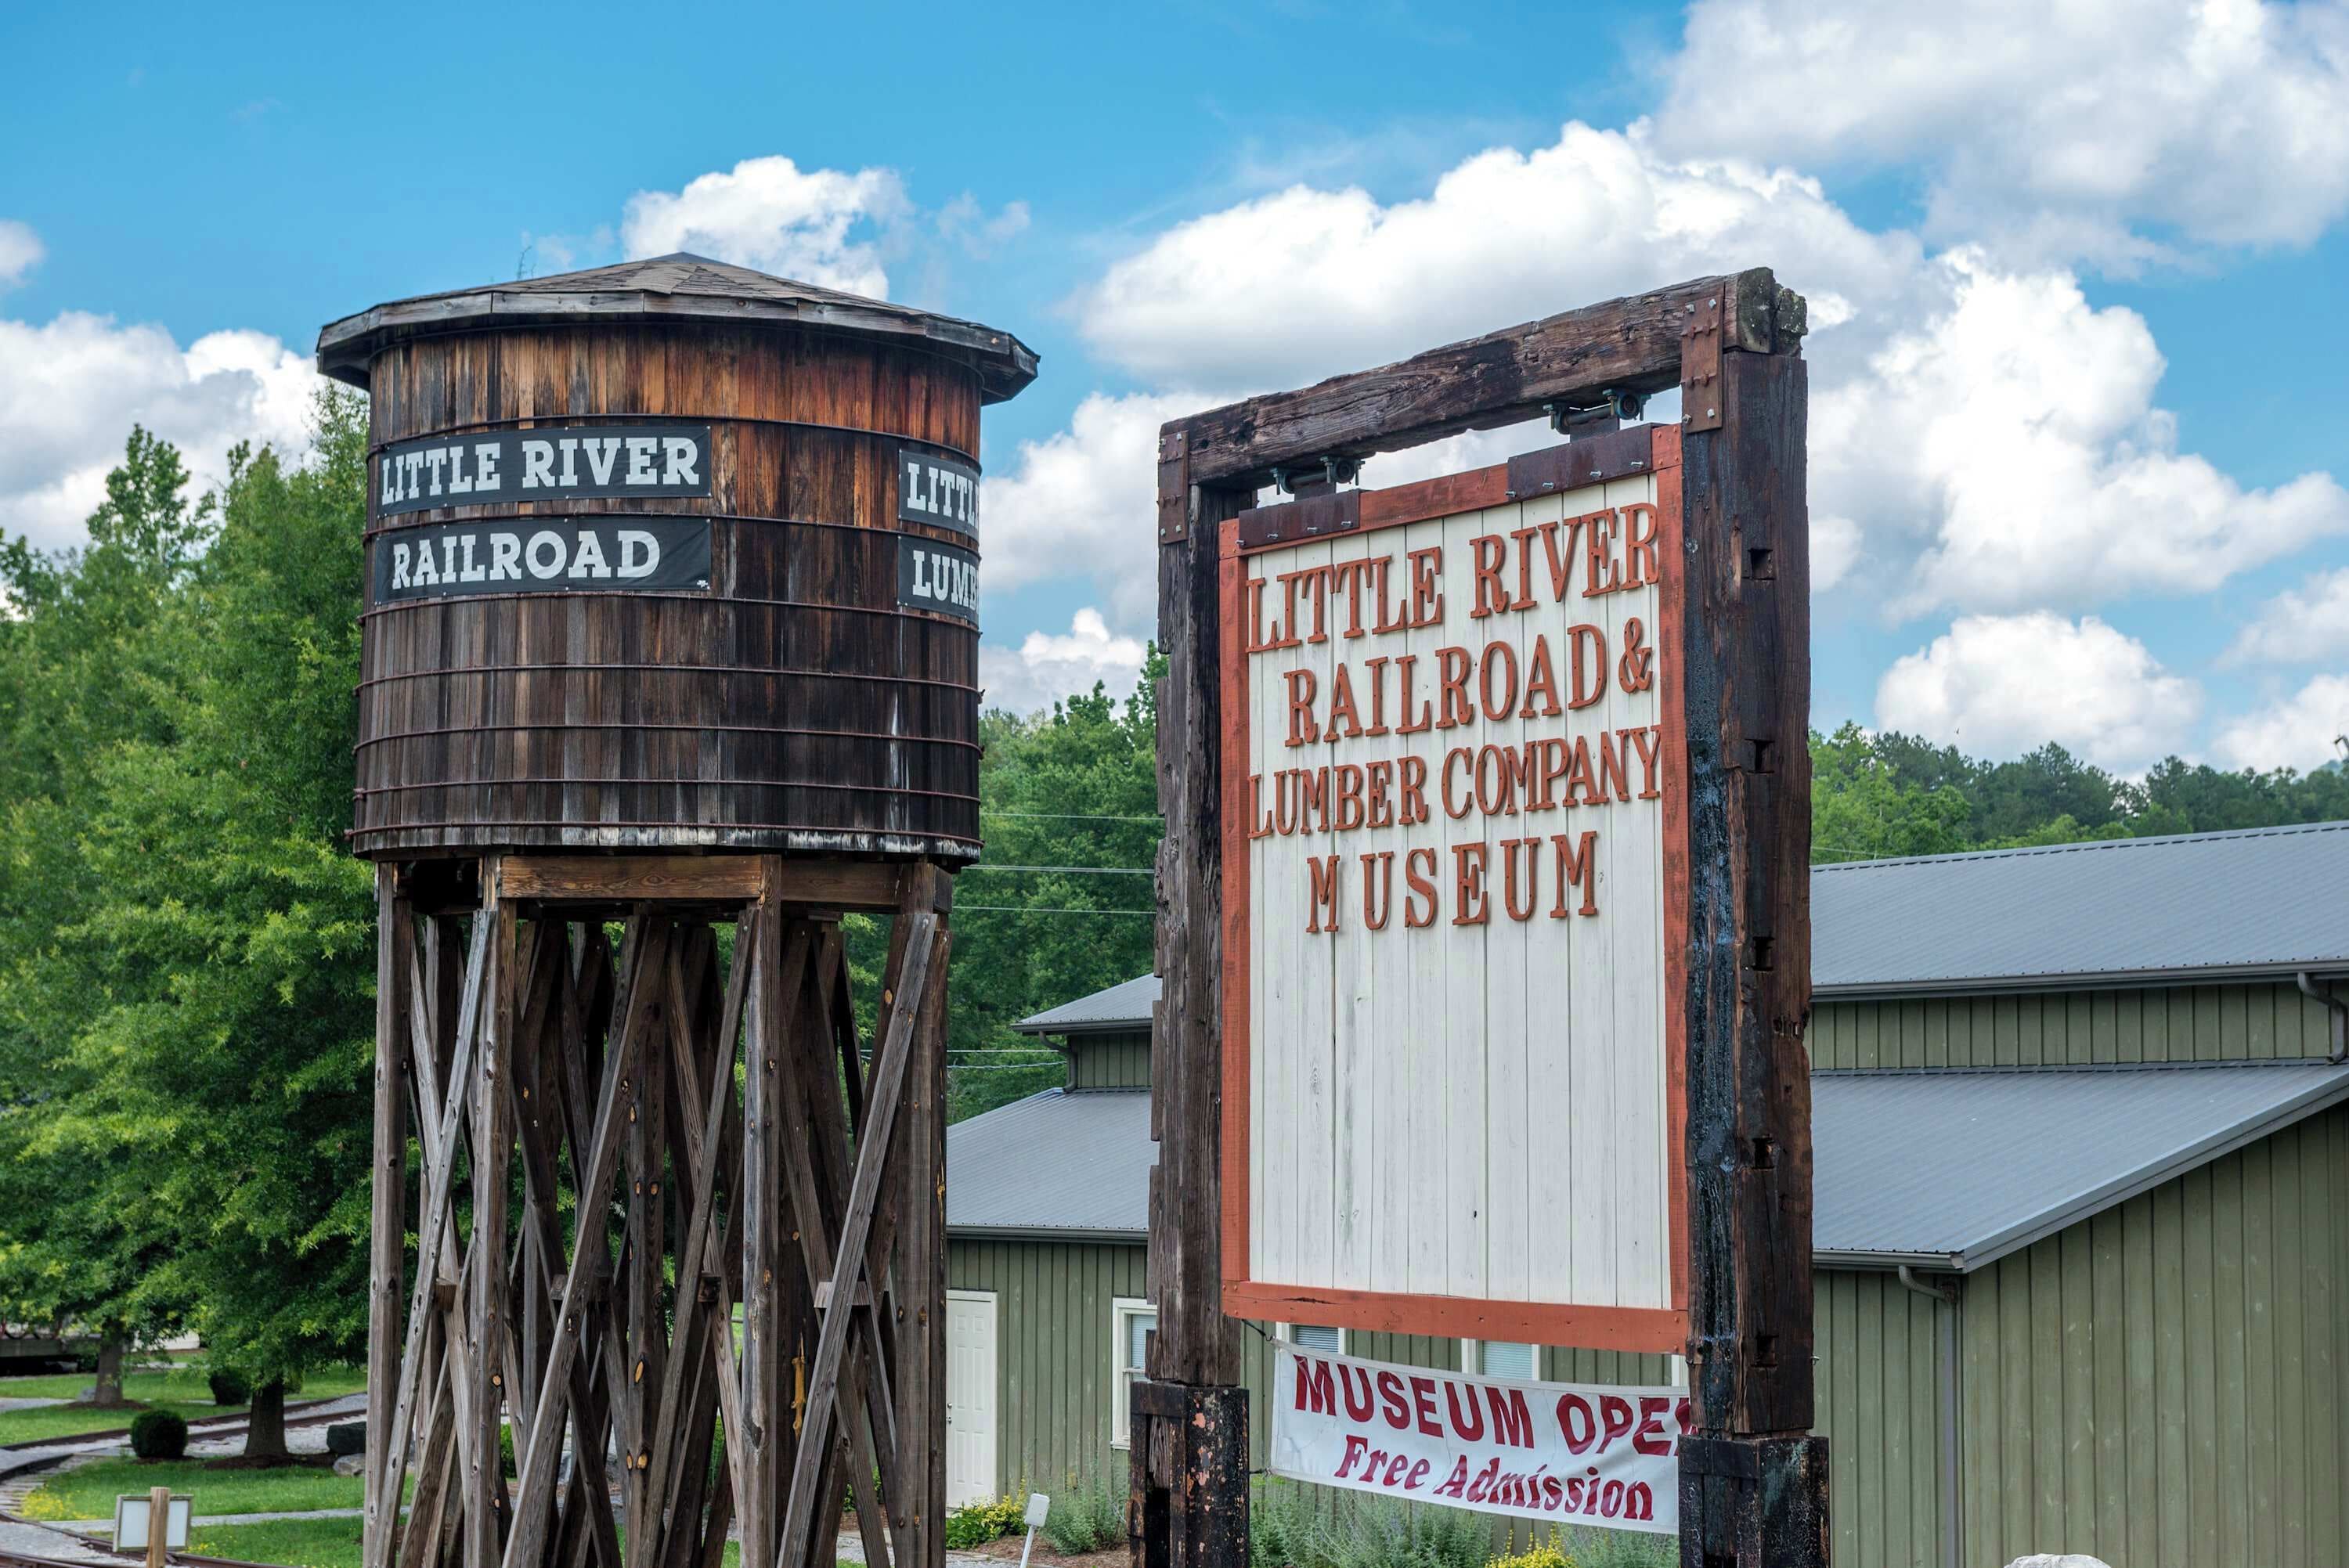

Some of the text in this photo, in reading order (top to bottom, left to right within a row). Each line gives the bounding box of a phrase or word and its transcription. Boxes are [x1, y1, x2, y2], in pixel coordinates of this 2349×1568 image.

[381, 437, 699, 506] LITTLE RIVER
[907, 462, 979, 530] LITTL
[392, 530, 661, 589] RAILROAD
[912, 550, 979, 614] LUMB
[1246, 502, 1659, 654] LITTLE RIVER
[1283, 616, 1654, 748] RAILROAD &
[1247, 724, 1662, 839] LUMBER COMPANY
[1305, 831, 1598, 933] MUSEUM
[1293, 1354, 1535, 1449] MUSEUM
[1334, 1434, 1654, 1521] Free Admission
